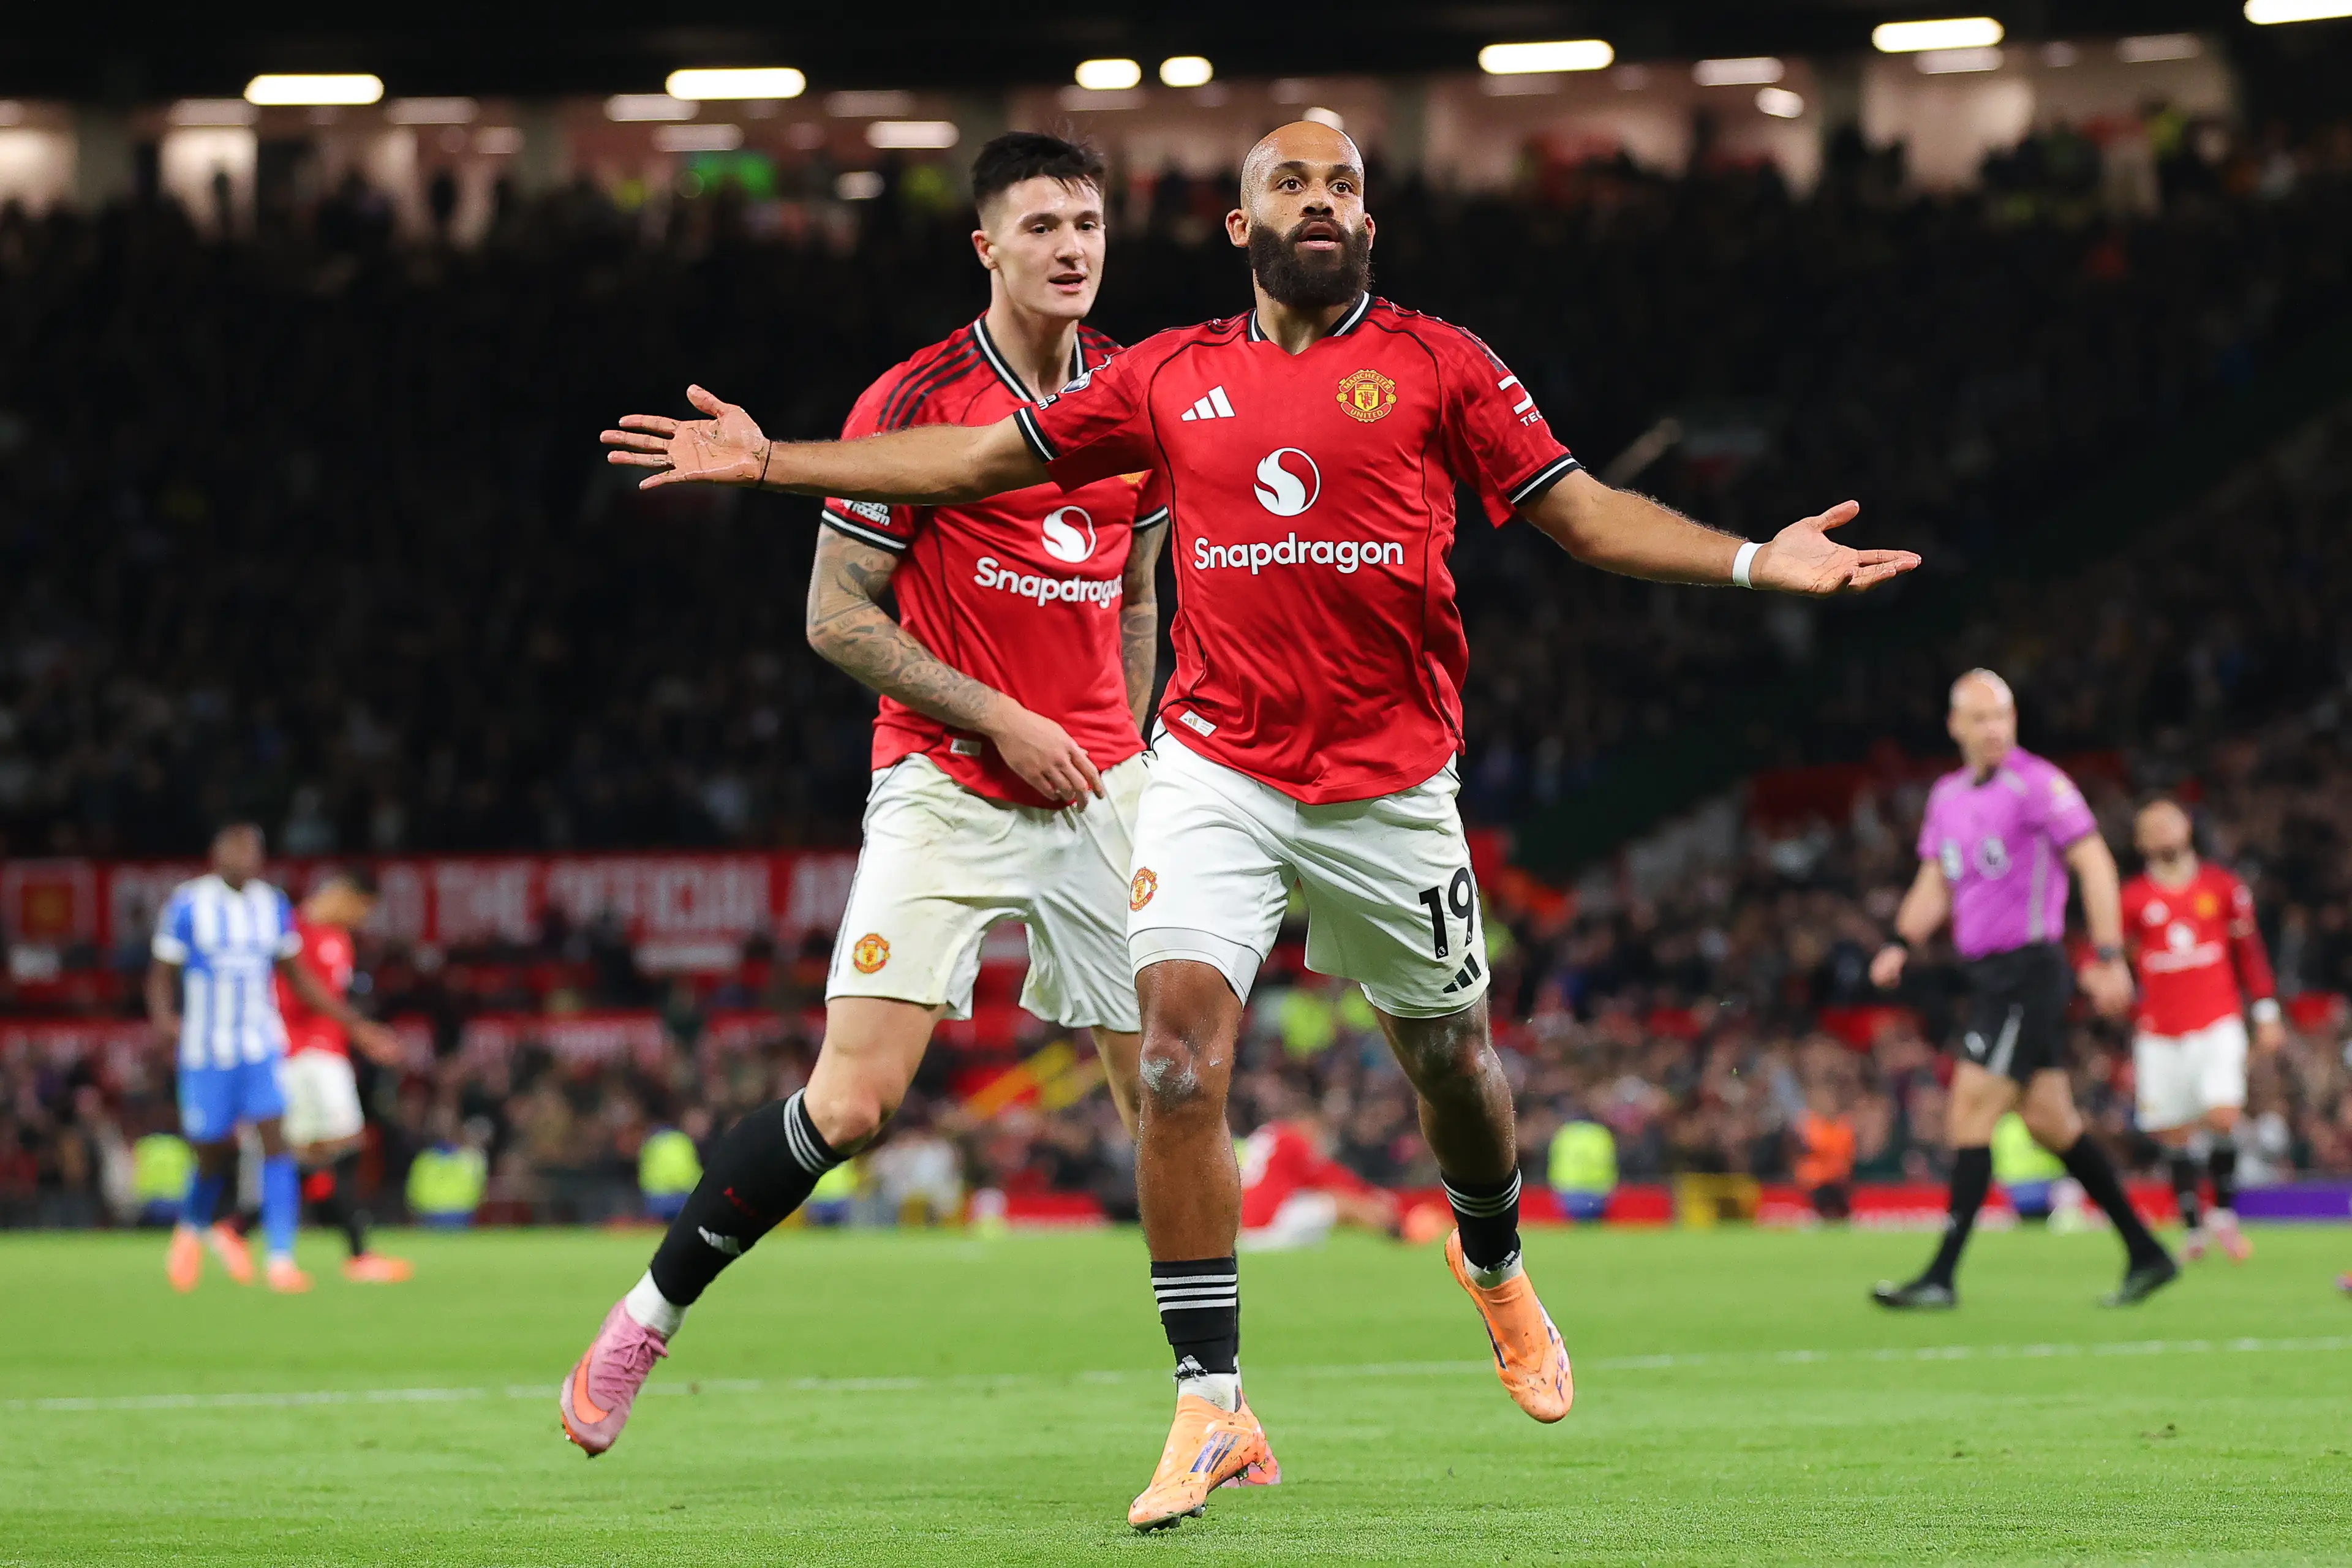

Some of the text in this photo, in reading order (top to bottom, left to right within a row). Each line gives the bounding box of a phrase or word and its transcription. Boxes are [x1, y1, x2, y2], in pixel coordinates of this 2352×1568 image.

[1343, 372, 1391, 390] MANCHESTER
[1350, 409, 1383, 418] UNITED
[1194, 532, 1404, 575] Snapdragon
[1419, 867, 1474, 959] 19
